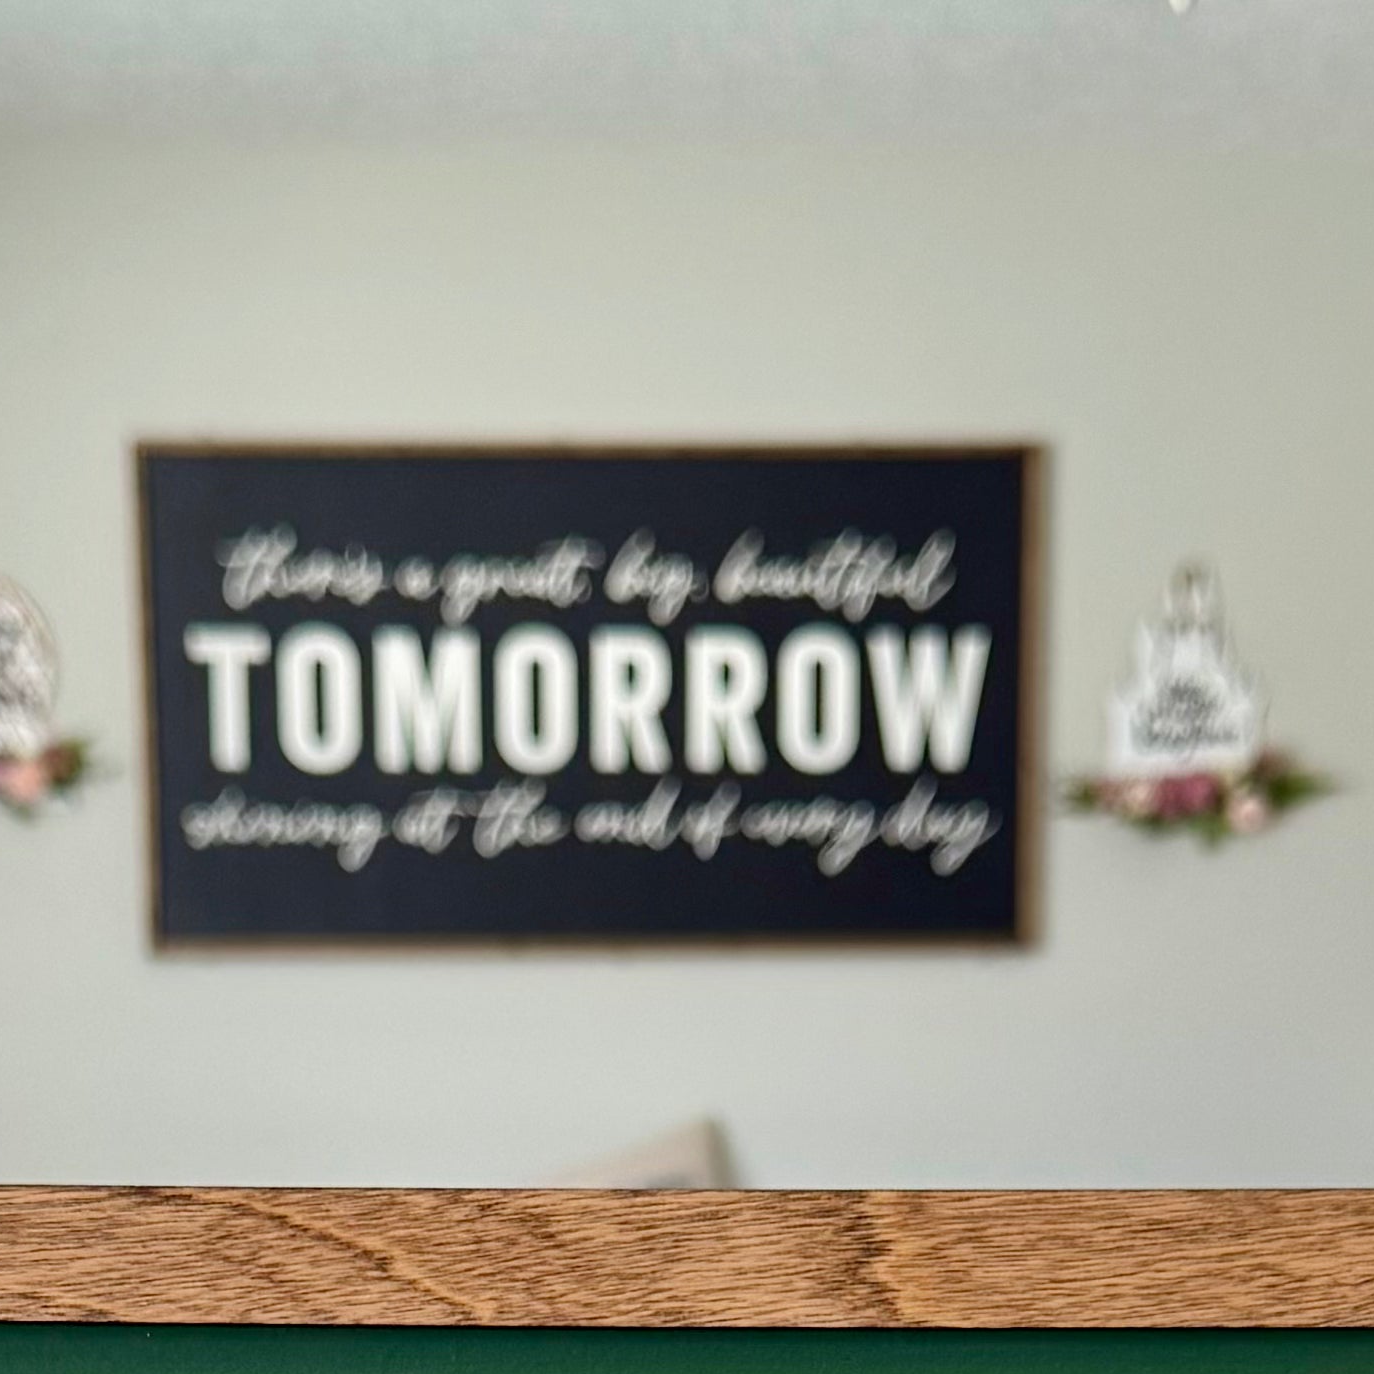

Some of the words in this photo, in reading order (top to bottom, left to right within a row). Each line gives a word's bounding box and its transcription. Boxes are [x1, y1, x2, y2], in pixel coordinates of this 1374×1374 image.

[394, 556, 438, 600] a
[440, 532, 604, 626] great
[604, 528, 707, 625] big
[714, 527, 955, 622] beautiful
[185, 624, 992, 774] TOMORROW
[393, 788, 478, 854] at
[472, 778, 569, 858] the
[575, 775, 682, 850] end
[680, 780, 740, 860] of
[879, 775, 1002, 876] day
